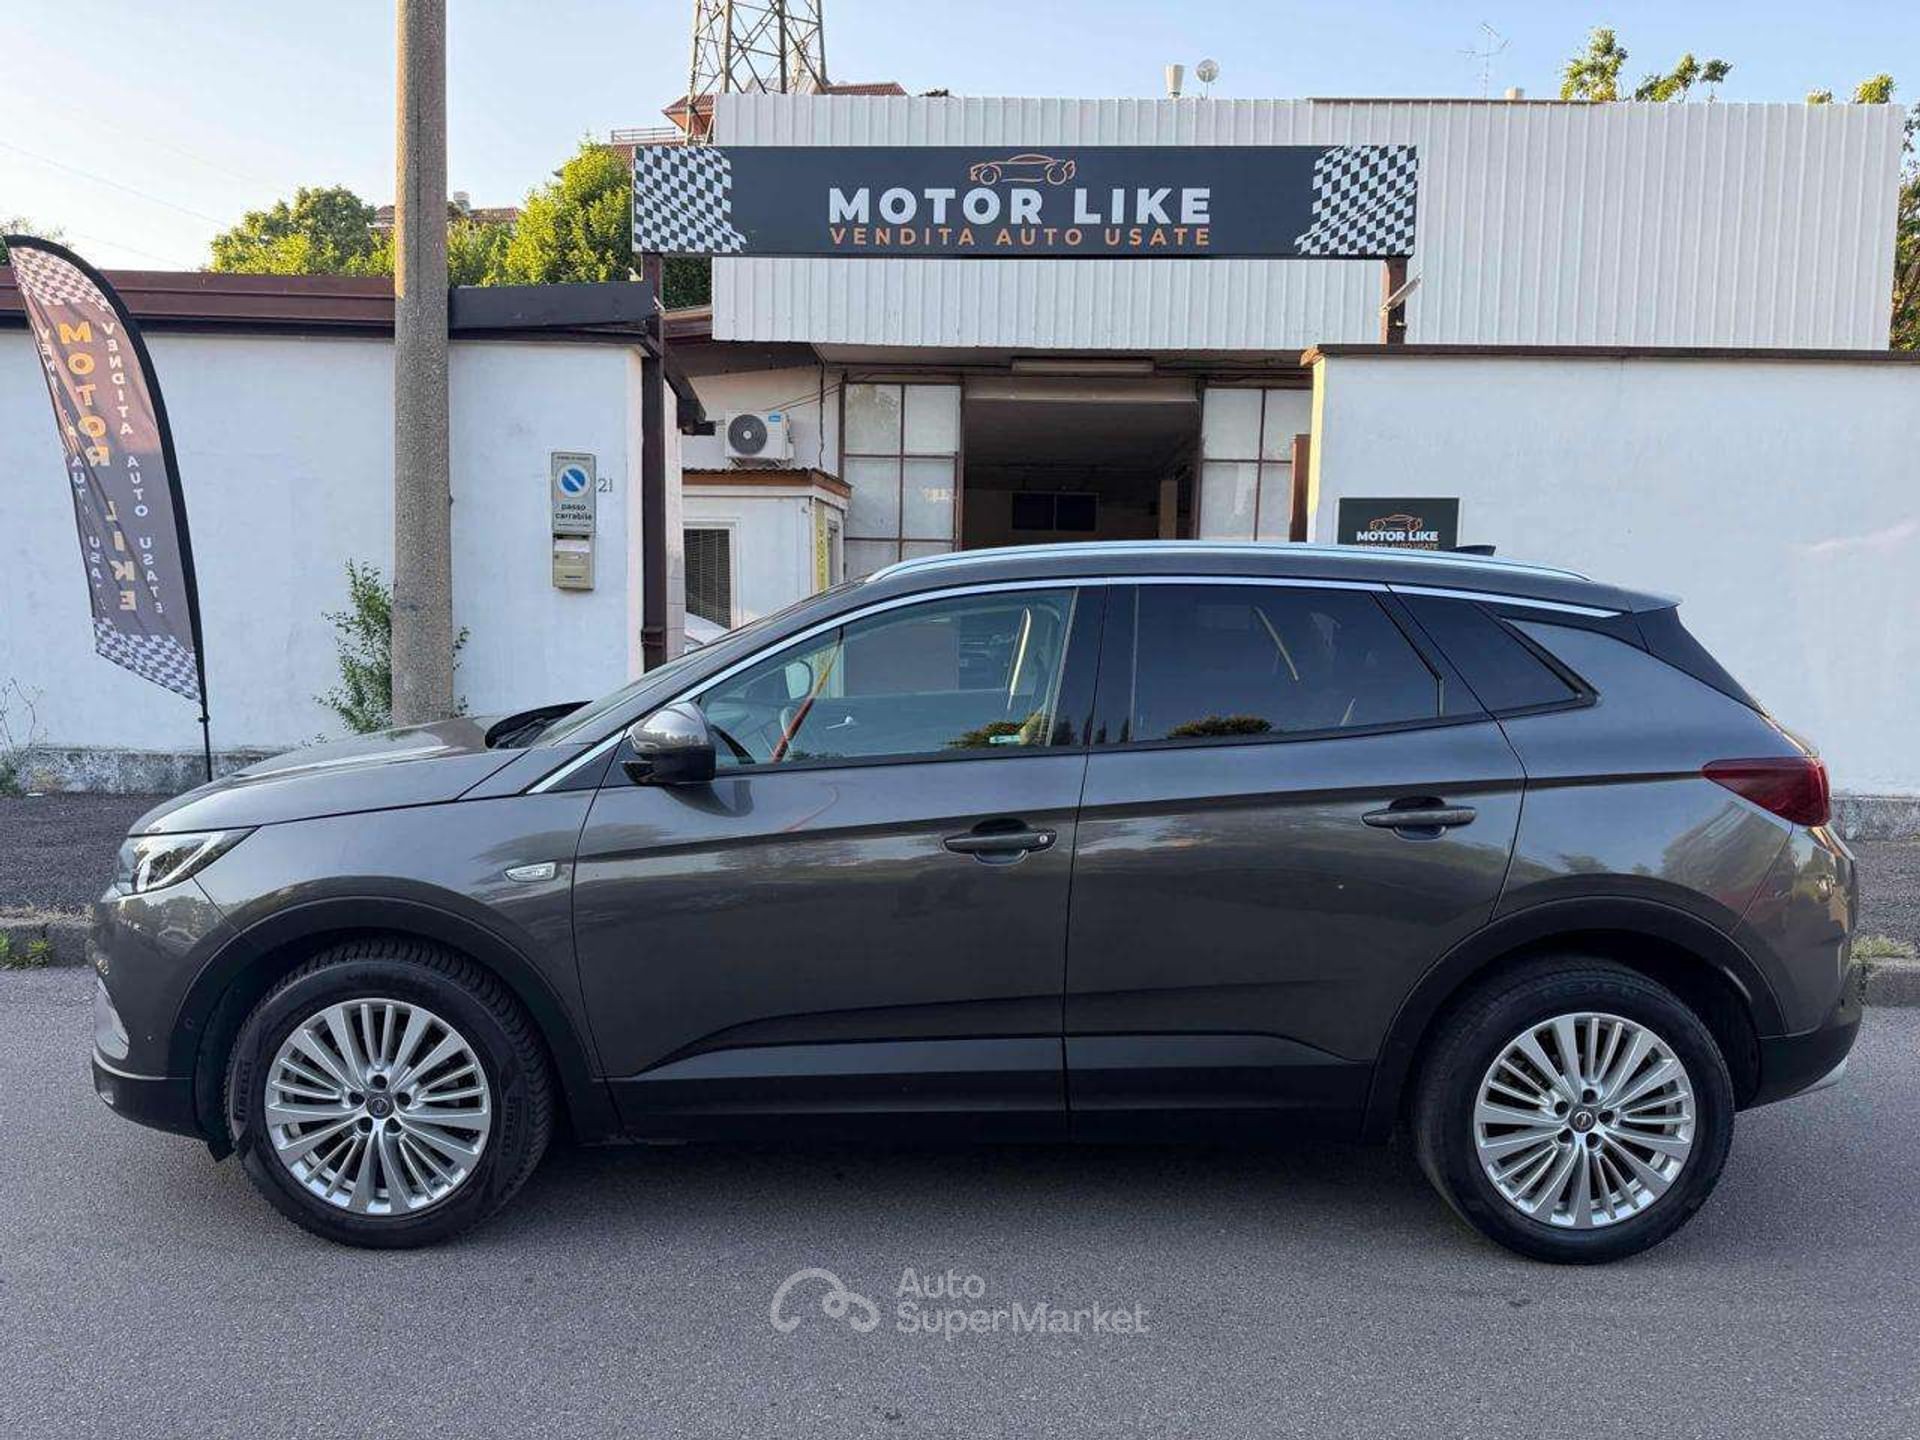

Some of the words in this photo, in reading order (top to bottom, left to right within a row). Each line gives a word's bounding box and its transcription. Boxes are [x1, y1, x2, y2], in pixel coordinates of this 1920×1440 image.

[829, 187, 1042, 225] MOTOR
[1074, 187, 1210, 225] LIKE
[830, 227, 975, 246] VENDITA
[996, 227, 1082, 246] AUTO
[1104, 227, 1210, 246] USATE
[1356, 531, 1405, 541] MOTOR
[1408, 531, 1439, 541] LIKE
